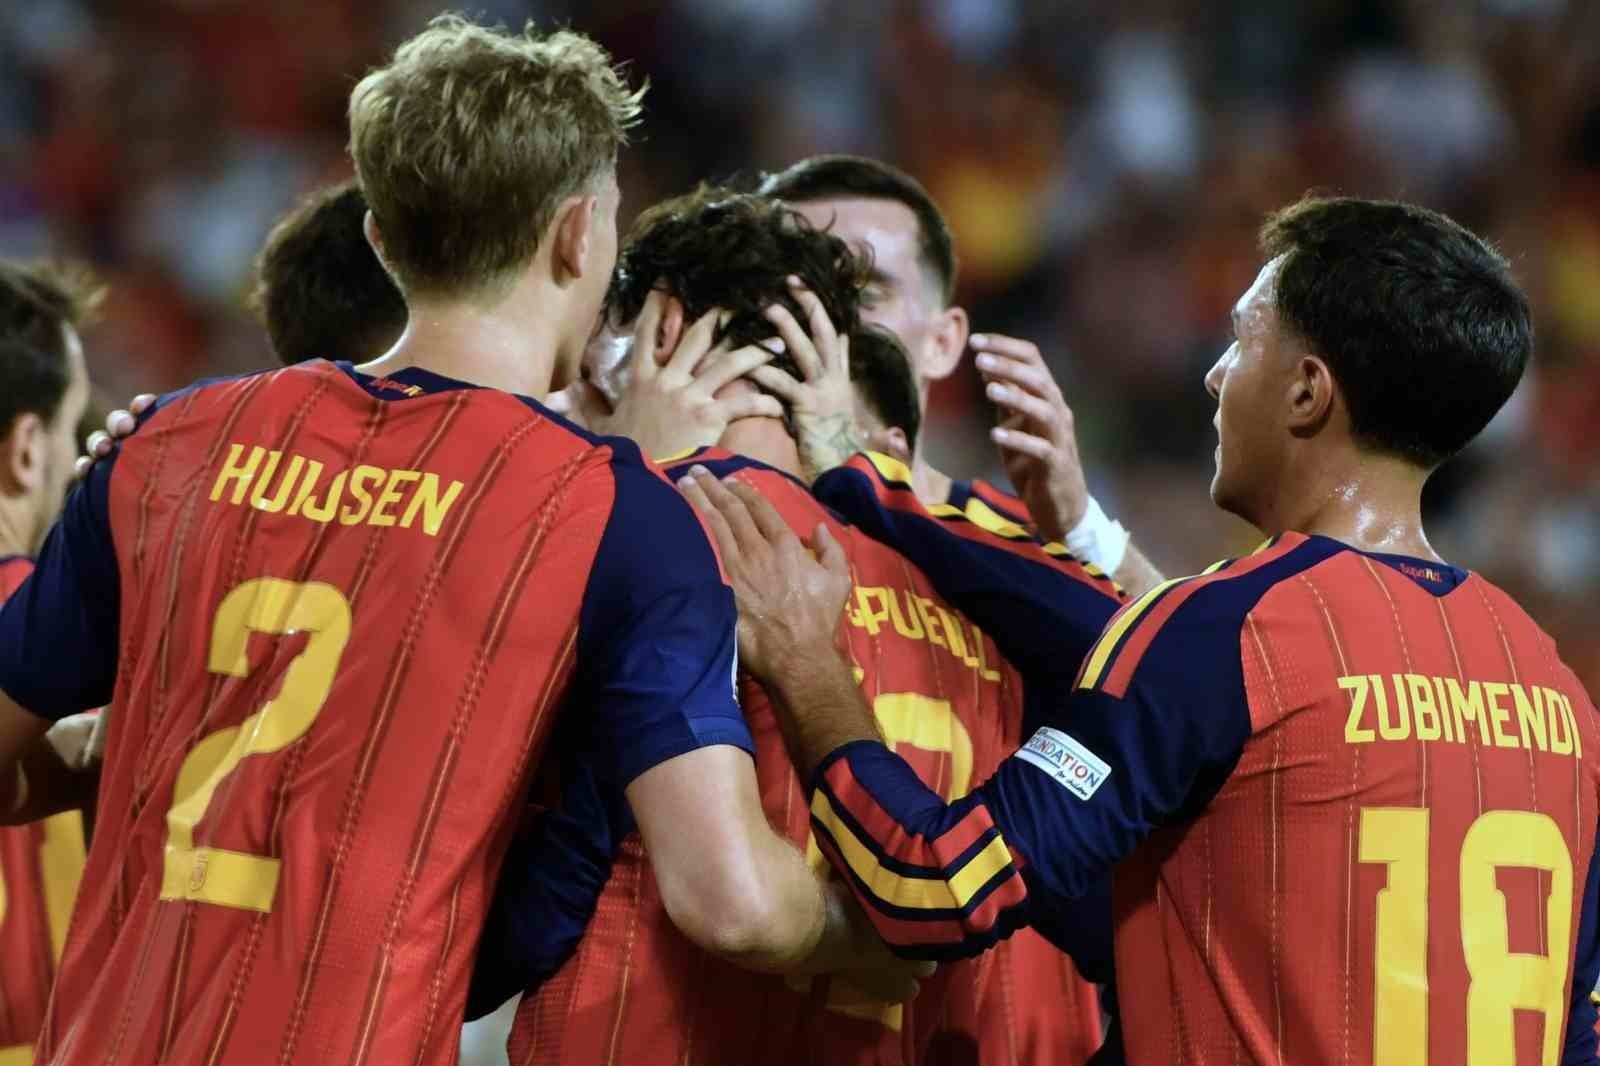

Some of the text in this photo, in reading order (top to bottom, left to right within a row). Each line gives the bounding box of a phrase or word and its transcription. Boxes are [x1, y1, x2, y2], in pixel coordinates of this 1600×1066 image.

[209, 443, 464, 537] HUIJSEN
[160, 576, 352, 914] 2
[1337, 673, 1583, 760] ZUBIMENDI
[1358, 807, 1574, 1066] 18
